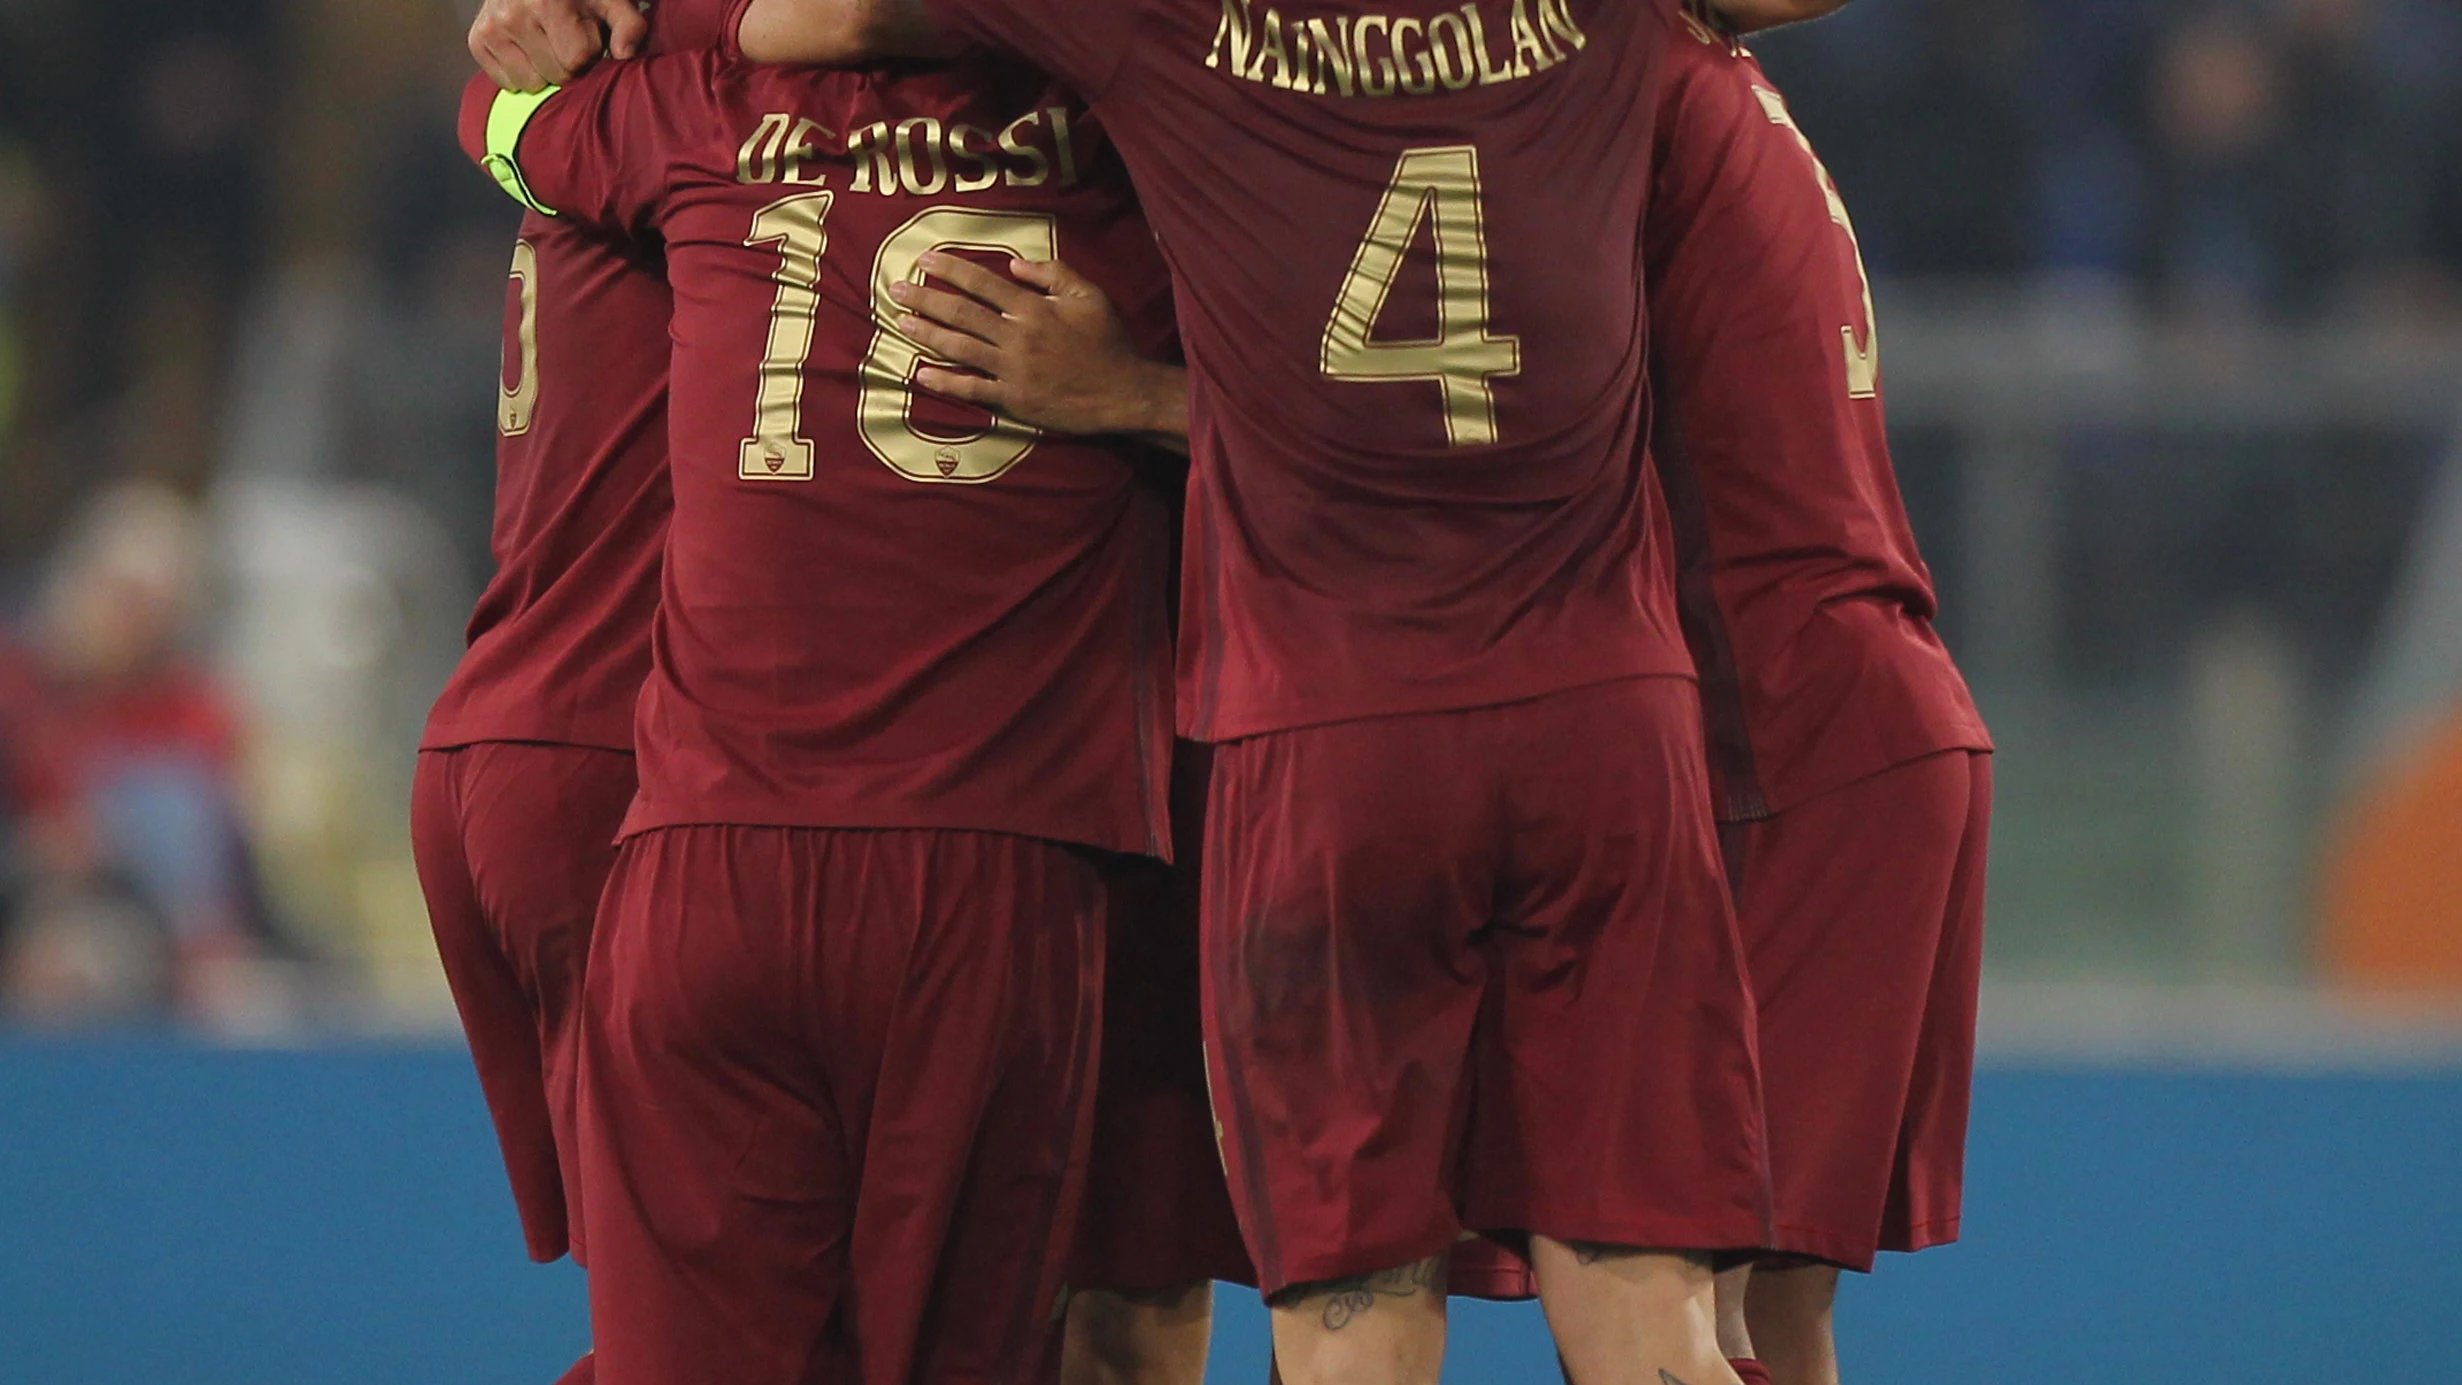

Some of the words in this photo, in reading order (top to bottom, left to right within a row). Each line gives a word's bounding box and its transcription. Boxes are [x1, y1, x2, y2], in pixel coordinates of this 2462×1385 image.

[1205, 0, 1586, 96] NAINGGOLAN
[735, 112, 837, 186] DE
[847, 106, 1081, 196] ROSSI
[1319, 144, 1521, 448] 4
